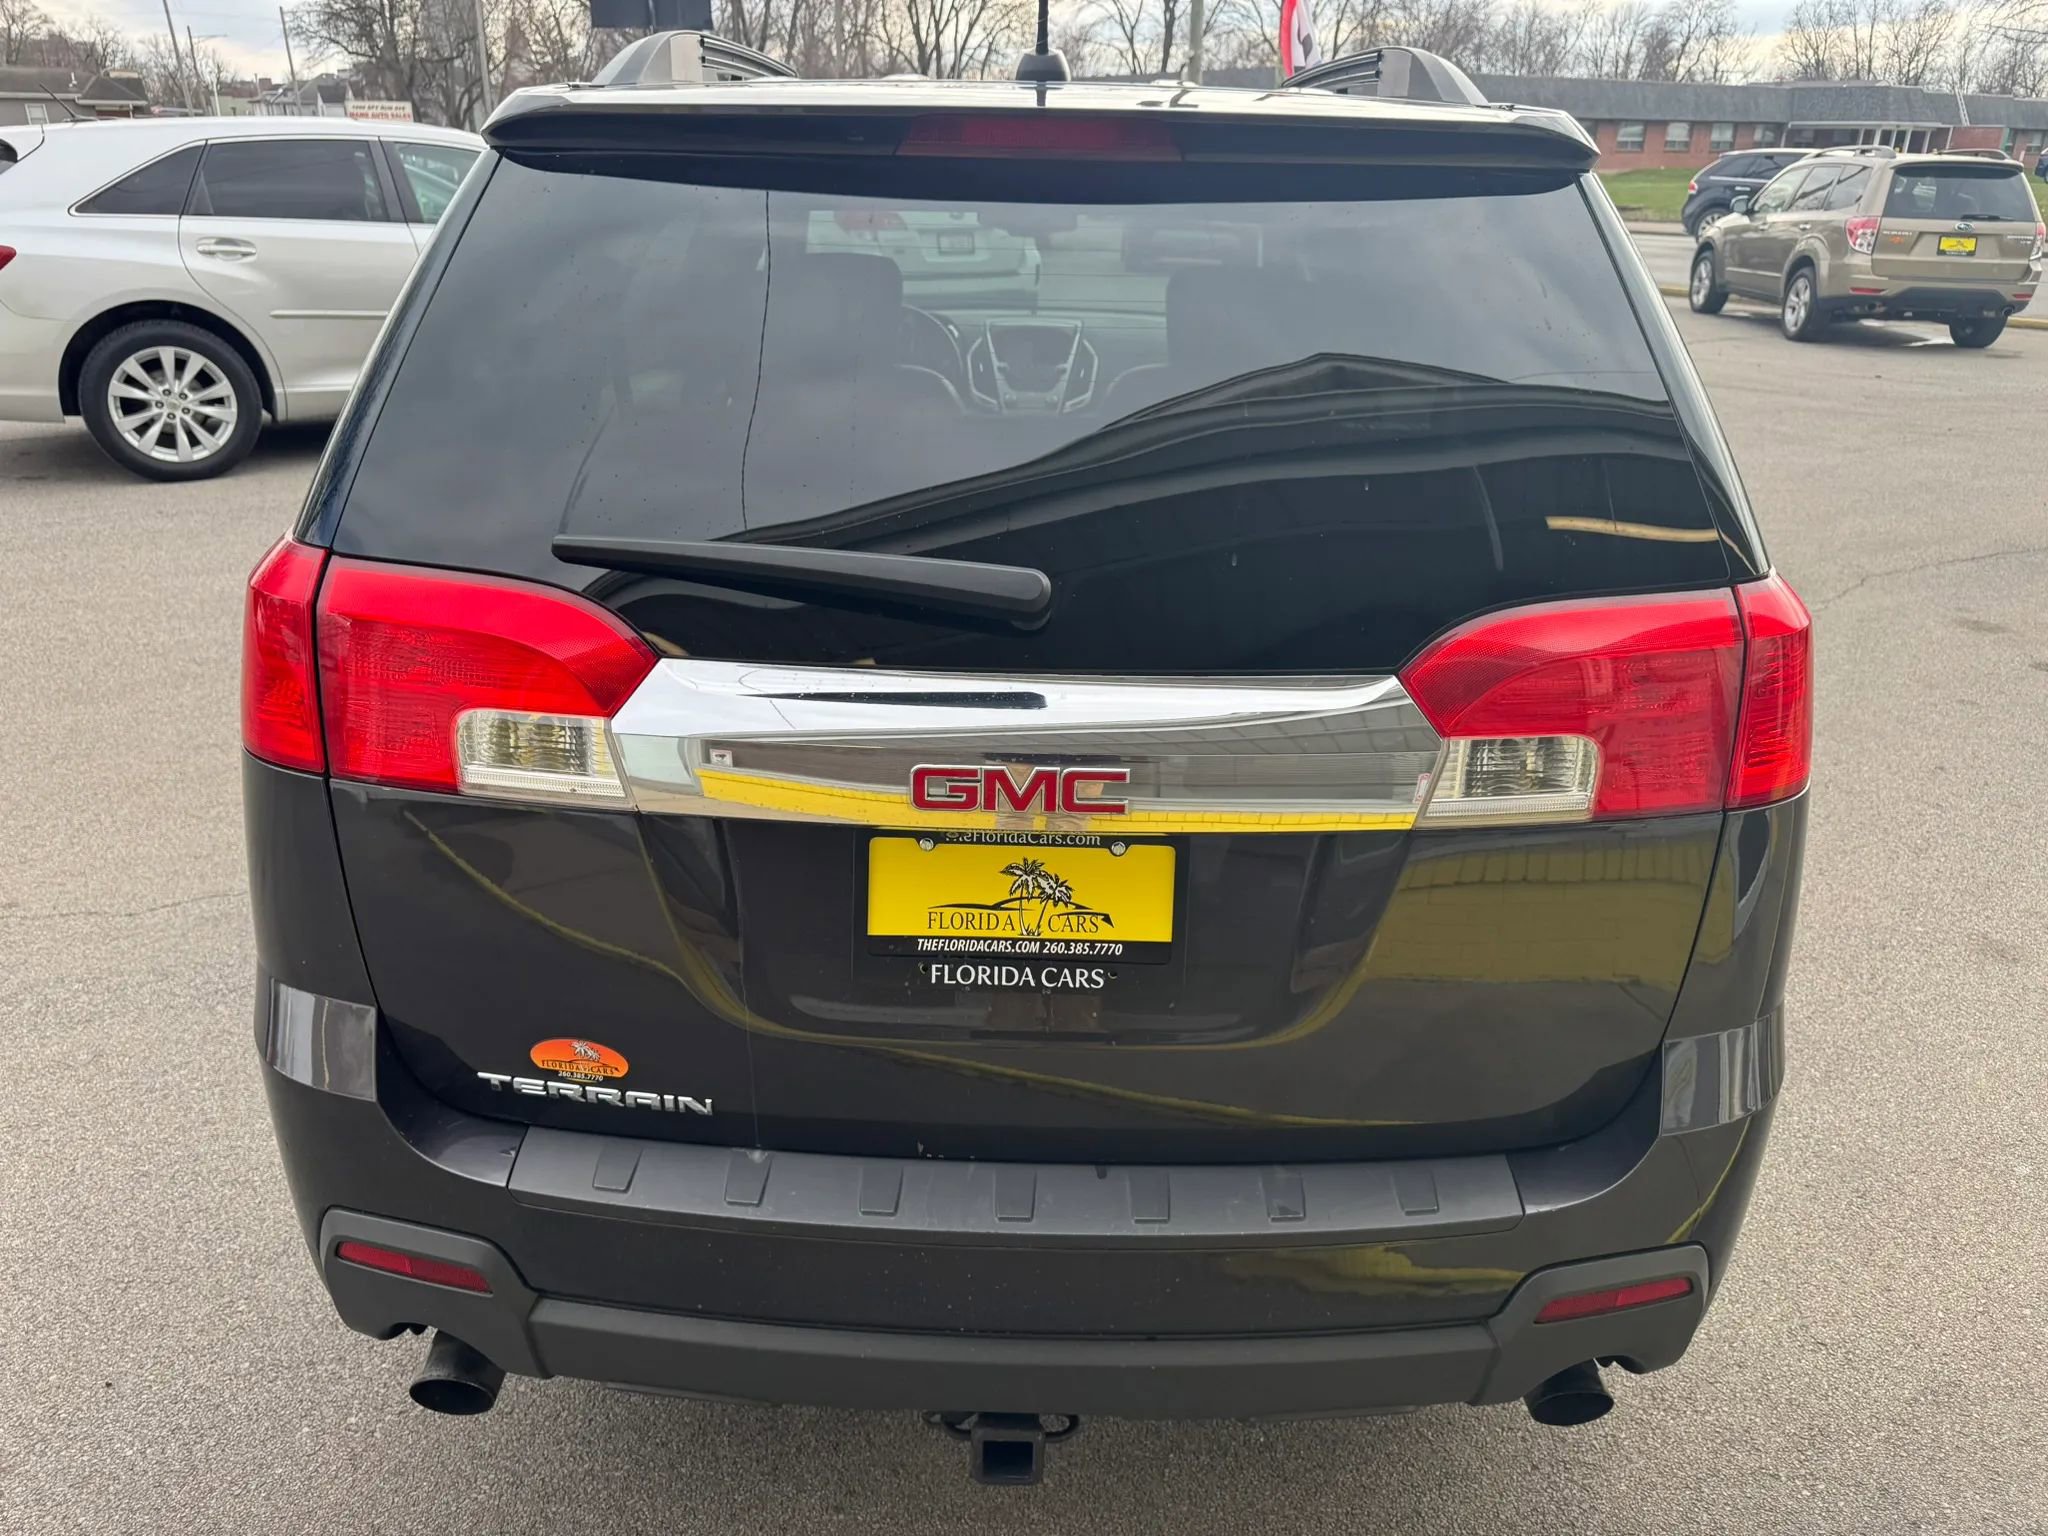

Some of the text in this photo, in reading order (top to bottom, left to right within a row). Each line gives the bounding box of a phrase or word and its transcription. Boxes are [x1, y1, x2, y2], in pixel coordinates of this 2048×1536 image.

[910, 764, 1131, 815] GMC
[927, 911, 1099, 934] FLORIDA CARS
[917, 938, 1123, 956] THEFLORIDACARS.COM 260.385.7770
[931, 964, 1105, 989] FLORIDA CARS
[541, 1059, 614, 1075] FLORIDA CARS
[477, 1071, 713, 1116] TERRAIN
